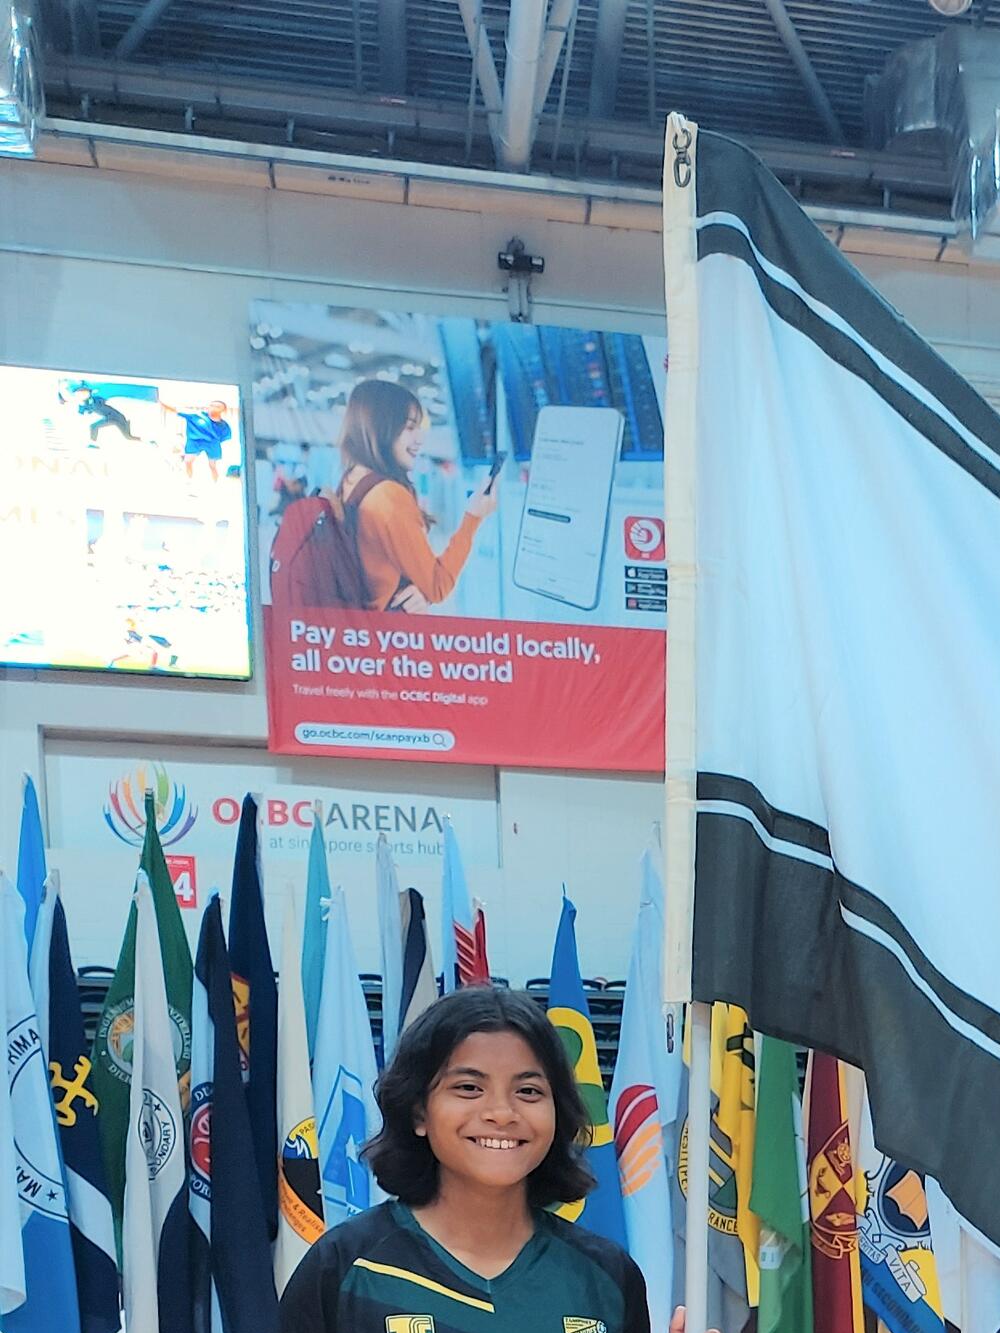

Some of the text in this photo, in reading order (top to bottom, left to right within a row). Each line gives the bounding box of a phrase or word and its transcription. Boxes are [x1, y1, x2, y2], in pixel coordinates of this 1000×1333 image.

[290, 620, 601, 665] Pay as you would locally,
[291, 648, 513, 683] all over the world
[292, 683, 489, 706] Travel freely with the OCBC Digital app
[212, 797, 443, 833] OBC ARENA
[269, 836, 283, 849] at
[288, 837, 362, 854] sinpore
[889, 1257, 911, 1292] VITA
